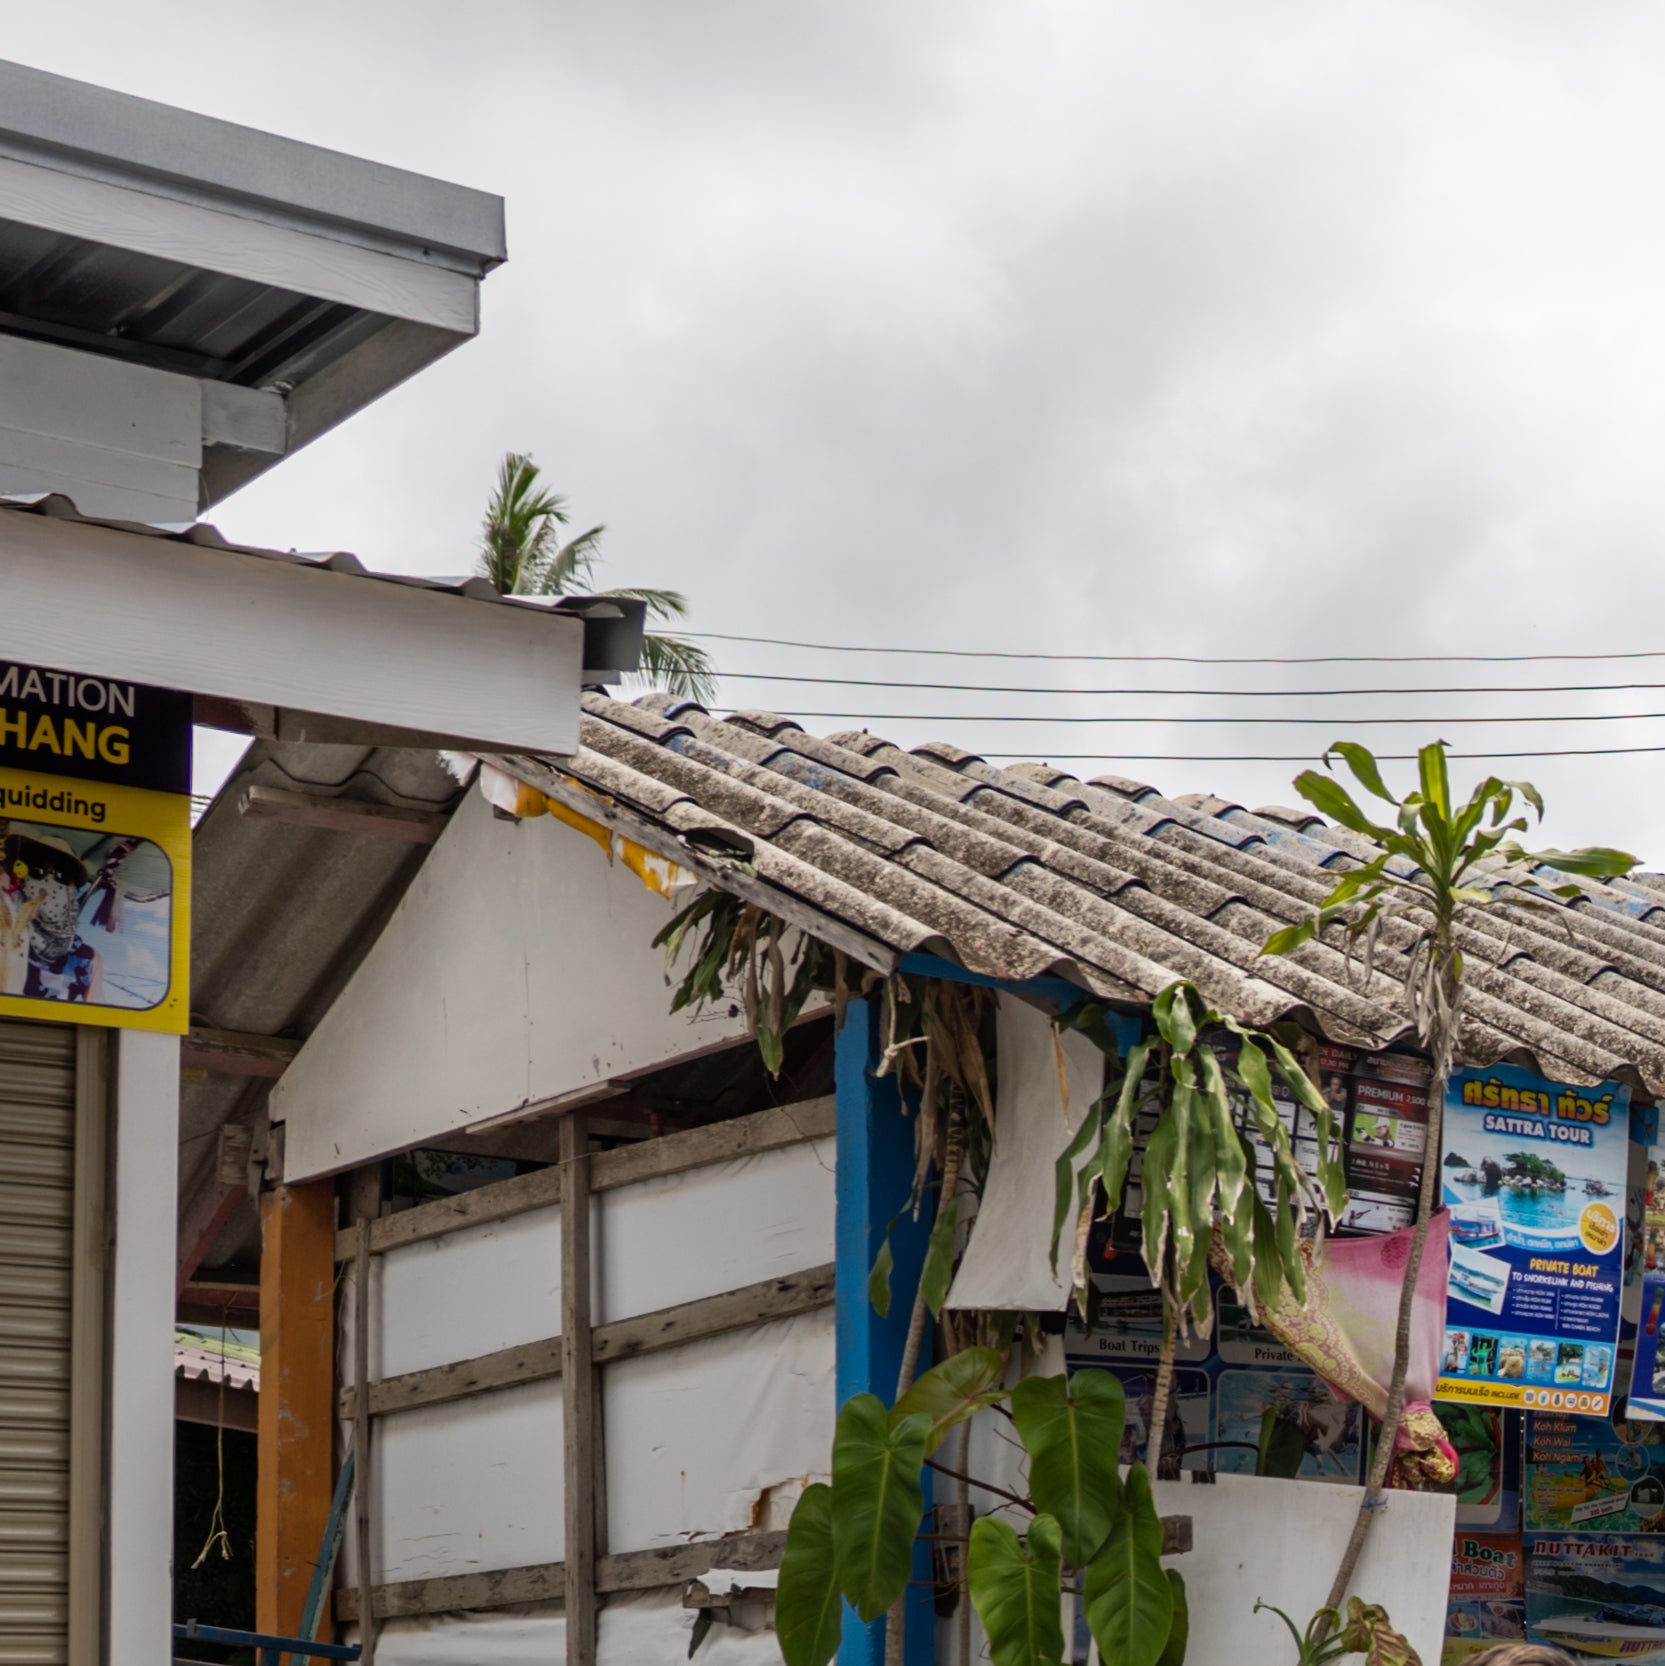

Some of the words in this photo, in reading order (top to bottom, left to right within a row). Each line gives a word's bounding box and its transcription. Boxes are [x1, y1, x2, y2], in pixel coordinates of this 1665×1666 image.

[0, 666, 135, 718] MATION
[0, 707, 130, 765] HANG
[1357, 1085, 1404, 1103] PREMIUM
[1557, 1089, 1614, 1125] ทัวร์
[1485, 1115, 1545, 1138] SATTRA
[1548, 1123, 1591, 1145] TOUR
[1529, 1257, 1570, 1275] PRIVATE
[1572, 1264, 1600, 1279] BOAT
[1512, 1271, 1521, 1281] TO
[1569, 1279, 1585, 1289] AND
[1100, 1338, 1129, 1352] Boat
[1131, 1340, 1160, 1355] Trips
[1255, 1348, 1294, 1362] Private
[1491, 1391, 1521, 1400] INCLUDE
[1533, 1421, 1552, 1432] Koh
[1553, 1422, 1577, 1434] Klum
[1533, 1436, 1552, 1446] Koh
[1553, 1437, 1571, 1448] Wai
[1533, 1451, 1552, 1462] Koh
[1552, 1452, 1582, 1464] Ngam
[1464, 1540, 1518, 1568] Boat
[1533, 1540, 1633, 1559] NUTTAKIT
